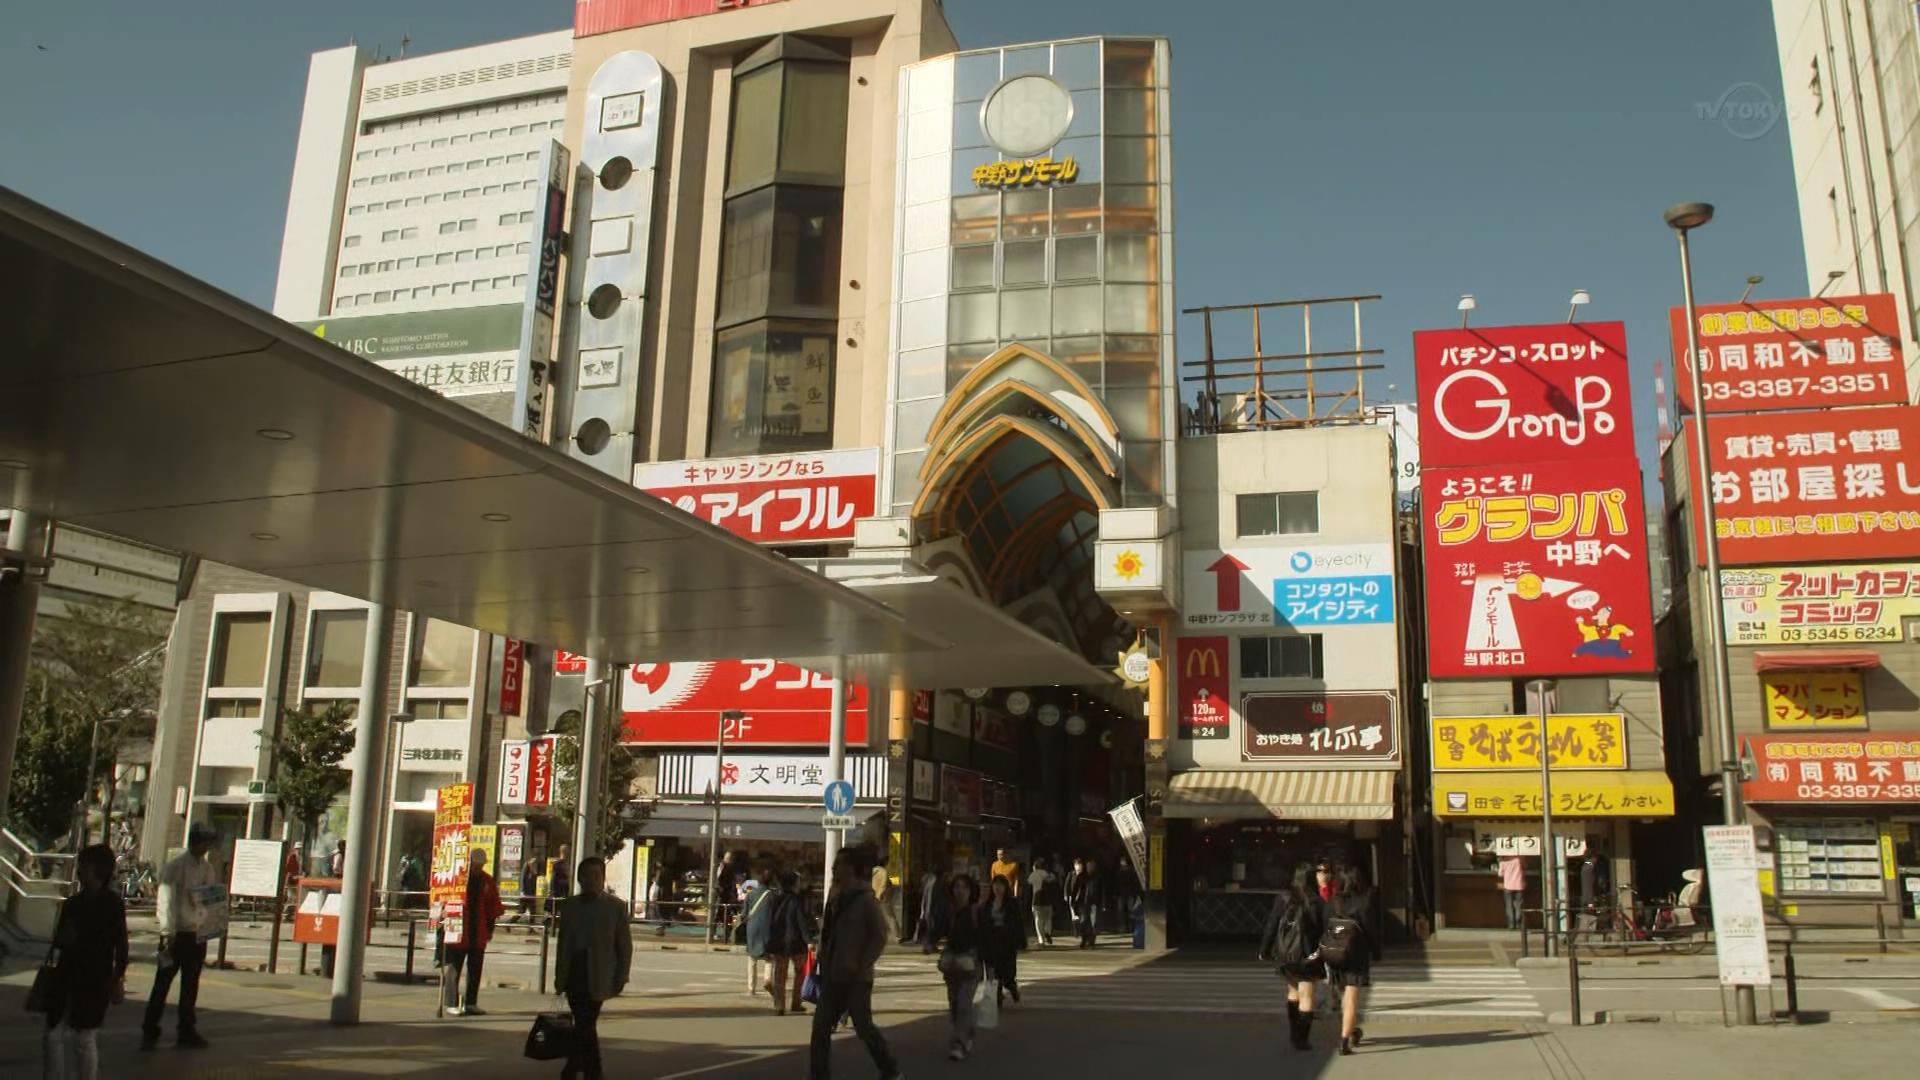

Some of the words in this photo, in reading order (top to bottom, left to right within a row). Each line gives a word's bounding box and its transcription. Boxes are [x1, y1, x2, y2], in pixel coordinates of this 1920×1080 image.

[684, 460, 824, 483] キャッシングなら
[1441, 474, 1533, 496] ようこそ!!
[701, 486, 855, 533] アイフル
[1435, 488, 1629, 545] グランパ
[1314, 552, 1373, 568] eyecity
[1546, 540, 1631, 567] 中野へ
[1286, 581, 1379, 599] コンタクトの
[1287, 601, 1379, 621] アイシティ
[1779, 601, 1881, 625] コミック
[1738, 622, 1766, 631] 24
[1780, 630, 1801, 641] 03
[1808, 629, 1849, 640] 5345
[1854, 627, 1897, 639] 6234
[1774, 682, 1857, 699] アパート
[1775, 704, 1859, 721] マンション
[722, 717, 753, 739] 2F
[1201, 728, 1215, 737] 24
[533, 755, 548, 801] アイフル
[750, 764, 823, 786] 文明堂
[1474, 796, 1505, 810] 田舎
[1559, 792, 1613, 812] うどん
[1620, 796, 1663, 808] かさい
